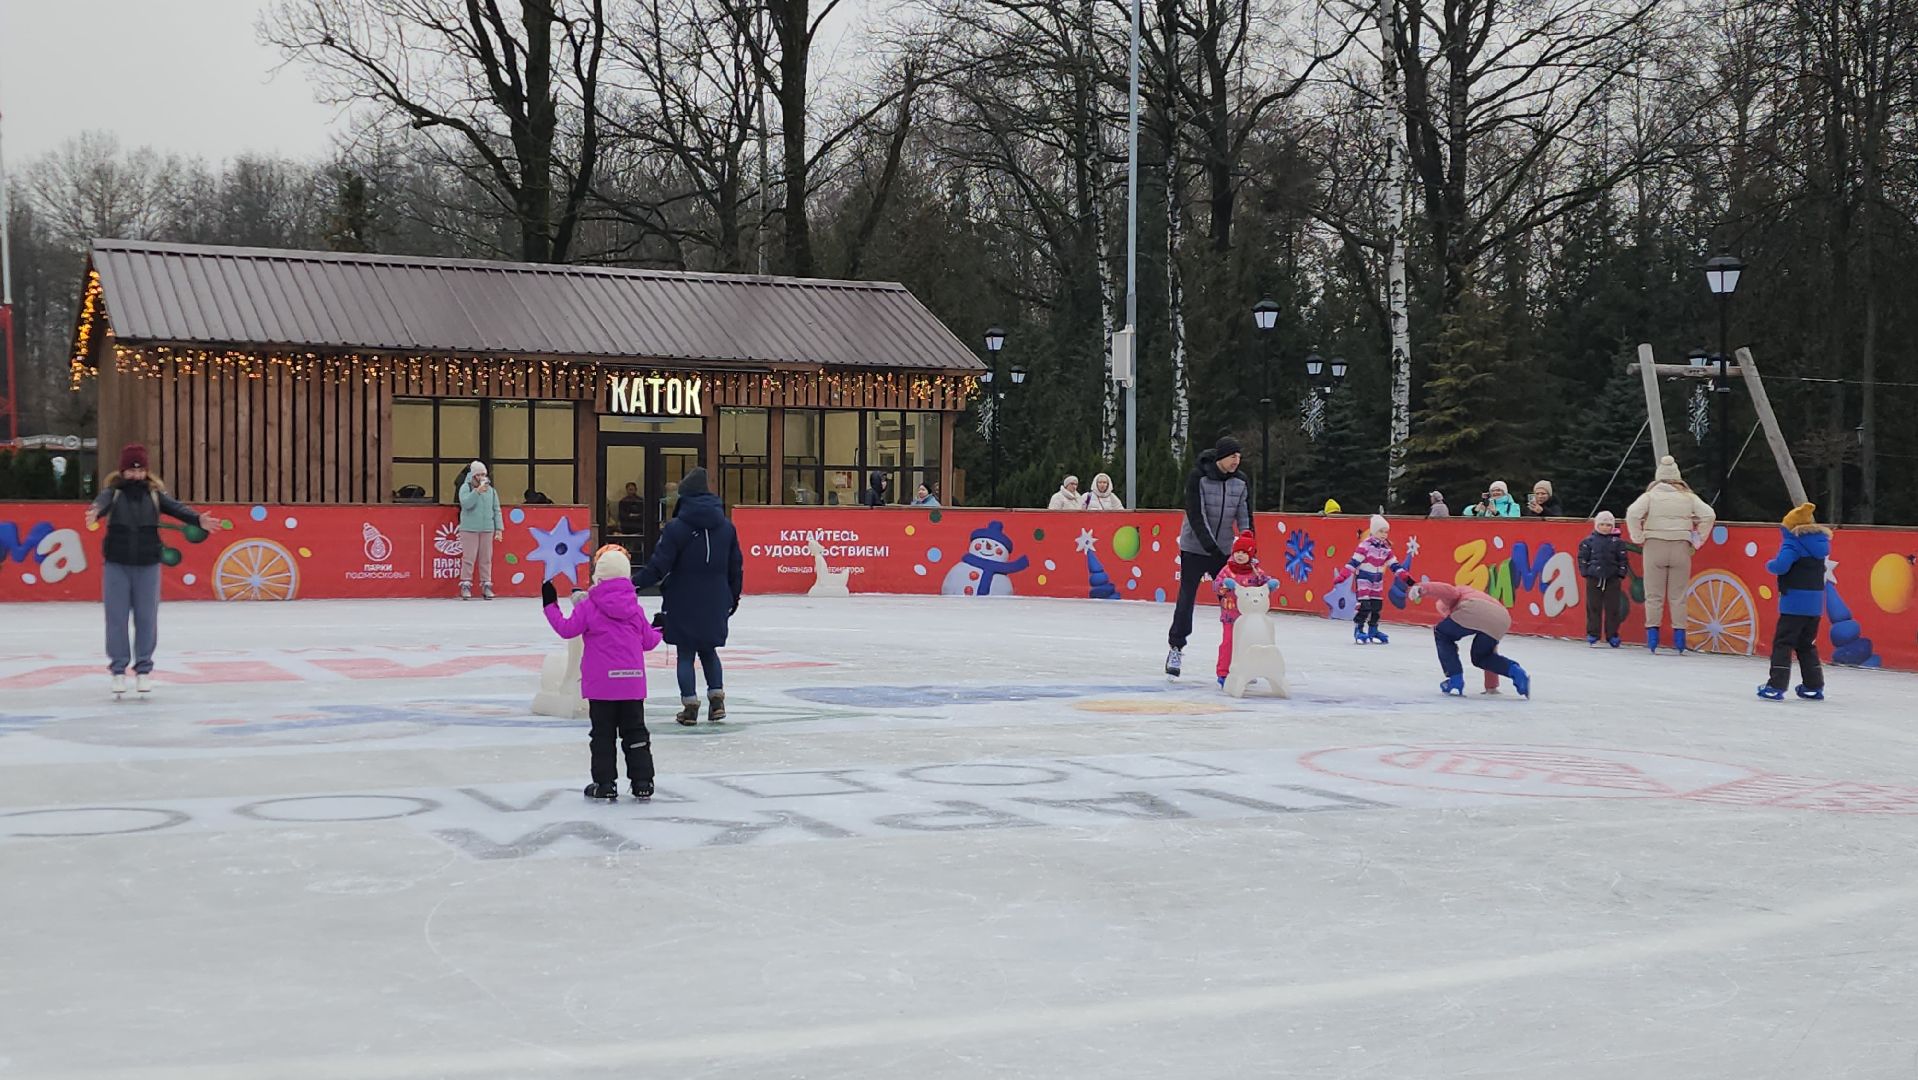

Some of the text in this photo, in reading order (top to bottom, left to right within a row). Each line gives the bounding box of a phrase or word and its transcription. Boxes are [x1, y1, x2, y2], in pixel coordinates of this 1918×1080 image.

[612, 376, 702, 415] КАТОК
[780, 528, 859, 542] КАТАЙТЕСЬ
[751, 545, 890, 558] С УДОВОЬСТВИЕМ!
[364, 563, 393, 572] ПАРКИ
[777, 564, 813, 574] Команда
[434, 783, 1402, 860] ПАРКИ
